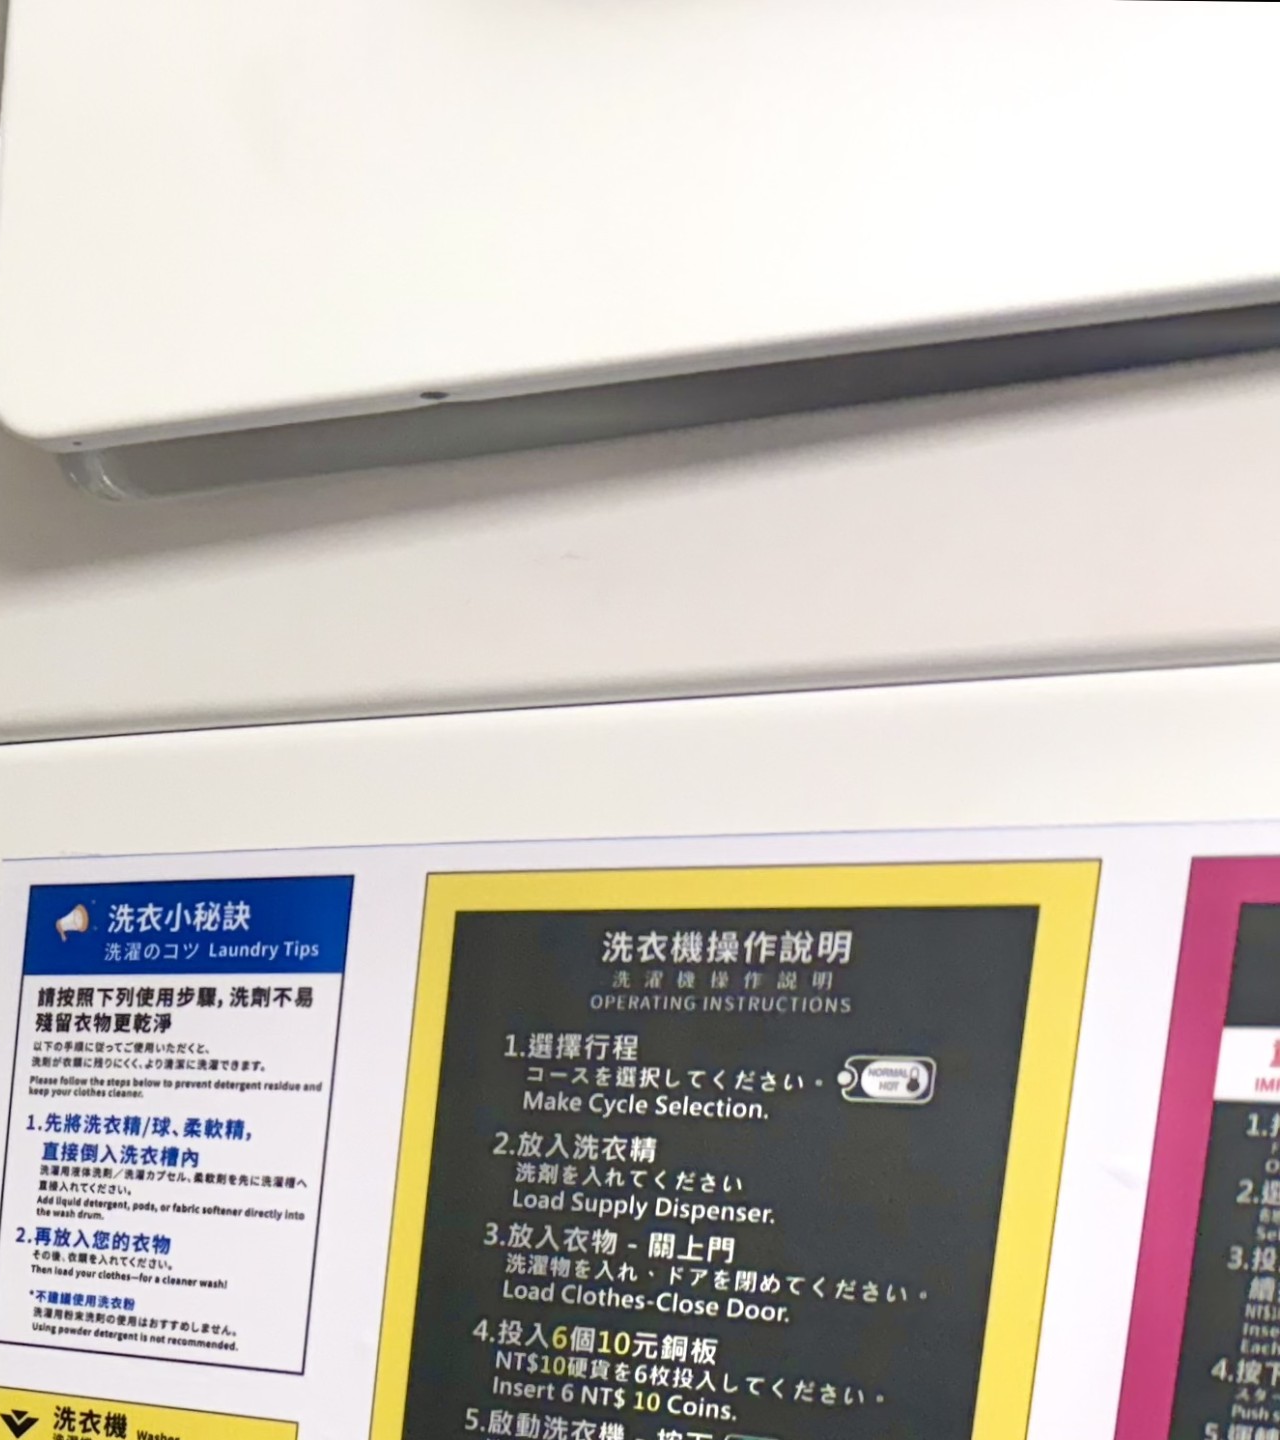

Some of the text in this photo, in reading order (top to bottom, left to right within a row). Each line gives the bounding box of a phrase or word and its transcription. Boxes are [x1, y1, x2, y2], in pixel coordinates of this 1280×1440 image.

[106, 900, 252, 935] 洗衣小秘訣
[104, 941, 319, 961] 洗濯のコツ Laundry Tips
[601, 931, 853, 965] 洗衣機操作說明
[590, 994, 852, 1014] OPERATING INSTRUCTIONS
[35, 1013, 172, 1034] 殘留衣物更乾淨
[504, 1033, 639, 1061] 1.選擇行程
[522, 1091, 769, 1120] Make Cycle Selection.
[493, 1131, 657, 1164] 2.放入洗衣精
[512, 1189, 775, 1226] Load Supply Dispenser.
[16, 1226, 172, 1256] 2.再放入您的衣物
[648, 1232, 736, 1263] 關上門
[502, 1279, 790, 1323] Load Clothes-Close Door.
[473, 1320, 719, 1365] 4.投入6個10元銅板
[492, 1376, 737, 1422] Insert 6 NT$ 10 Coins.
[53, 1405, 128, 1440] 洗衣機
